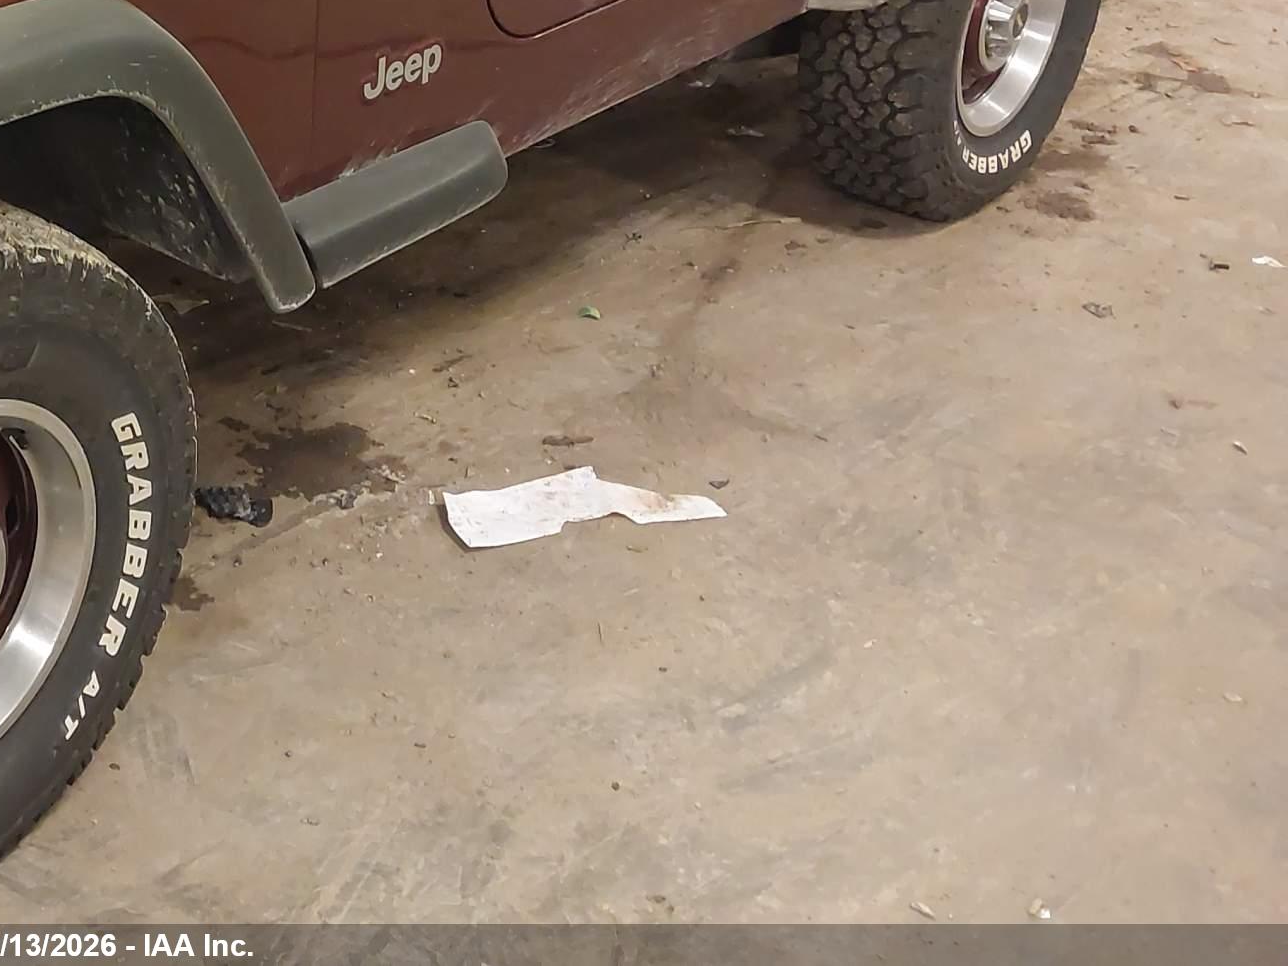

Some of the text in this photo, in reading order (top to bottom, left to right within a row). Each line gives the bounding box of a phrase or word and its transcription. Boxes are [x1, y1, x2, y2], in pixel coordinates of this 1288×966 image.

[364, 44, 442, 100] Jeep
[962, 130, 1033, 174] GRABBER
[64, 412, 153, 740] GRABBER A/T
